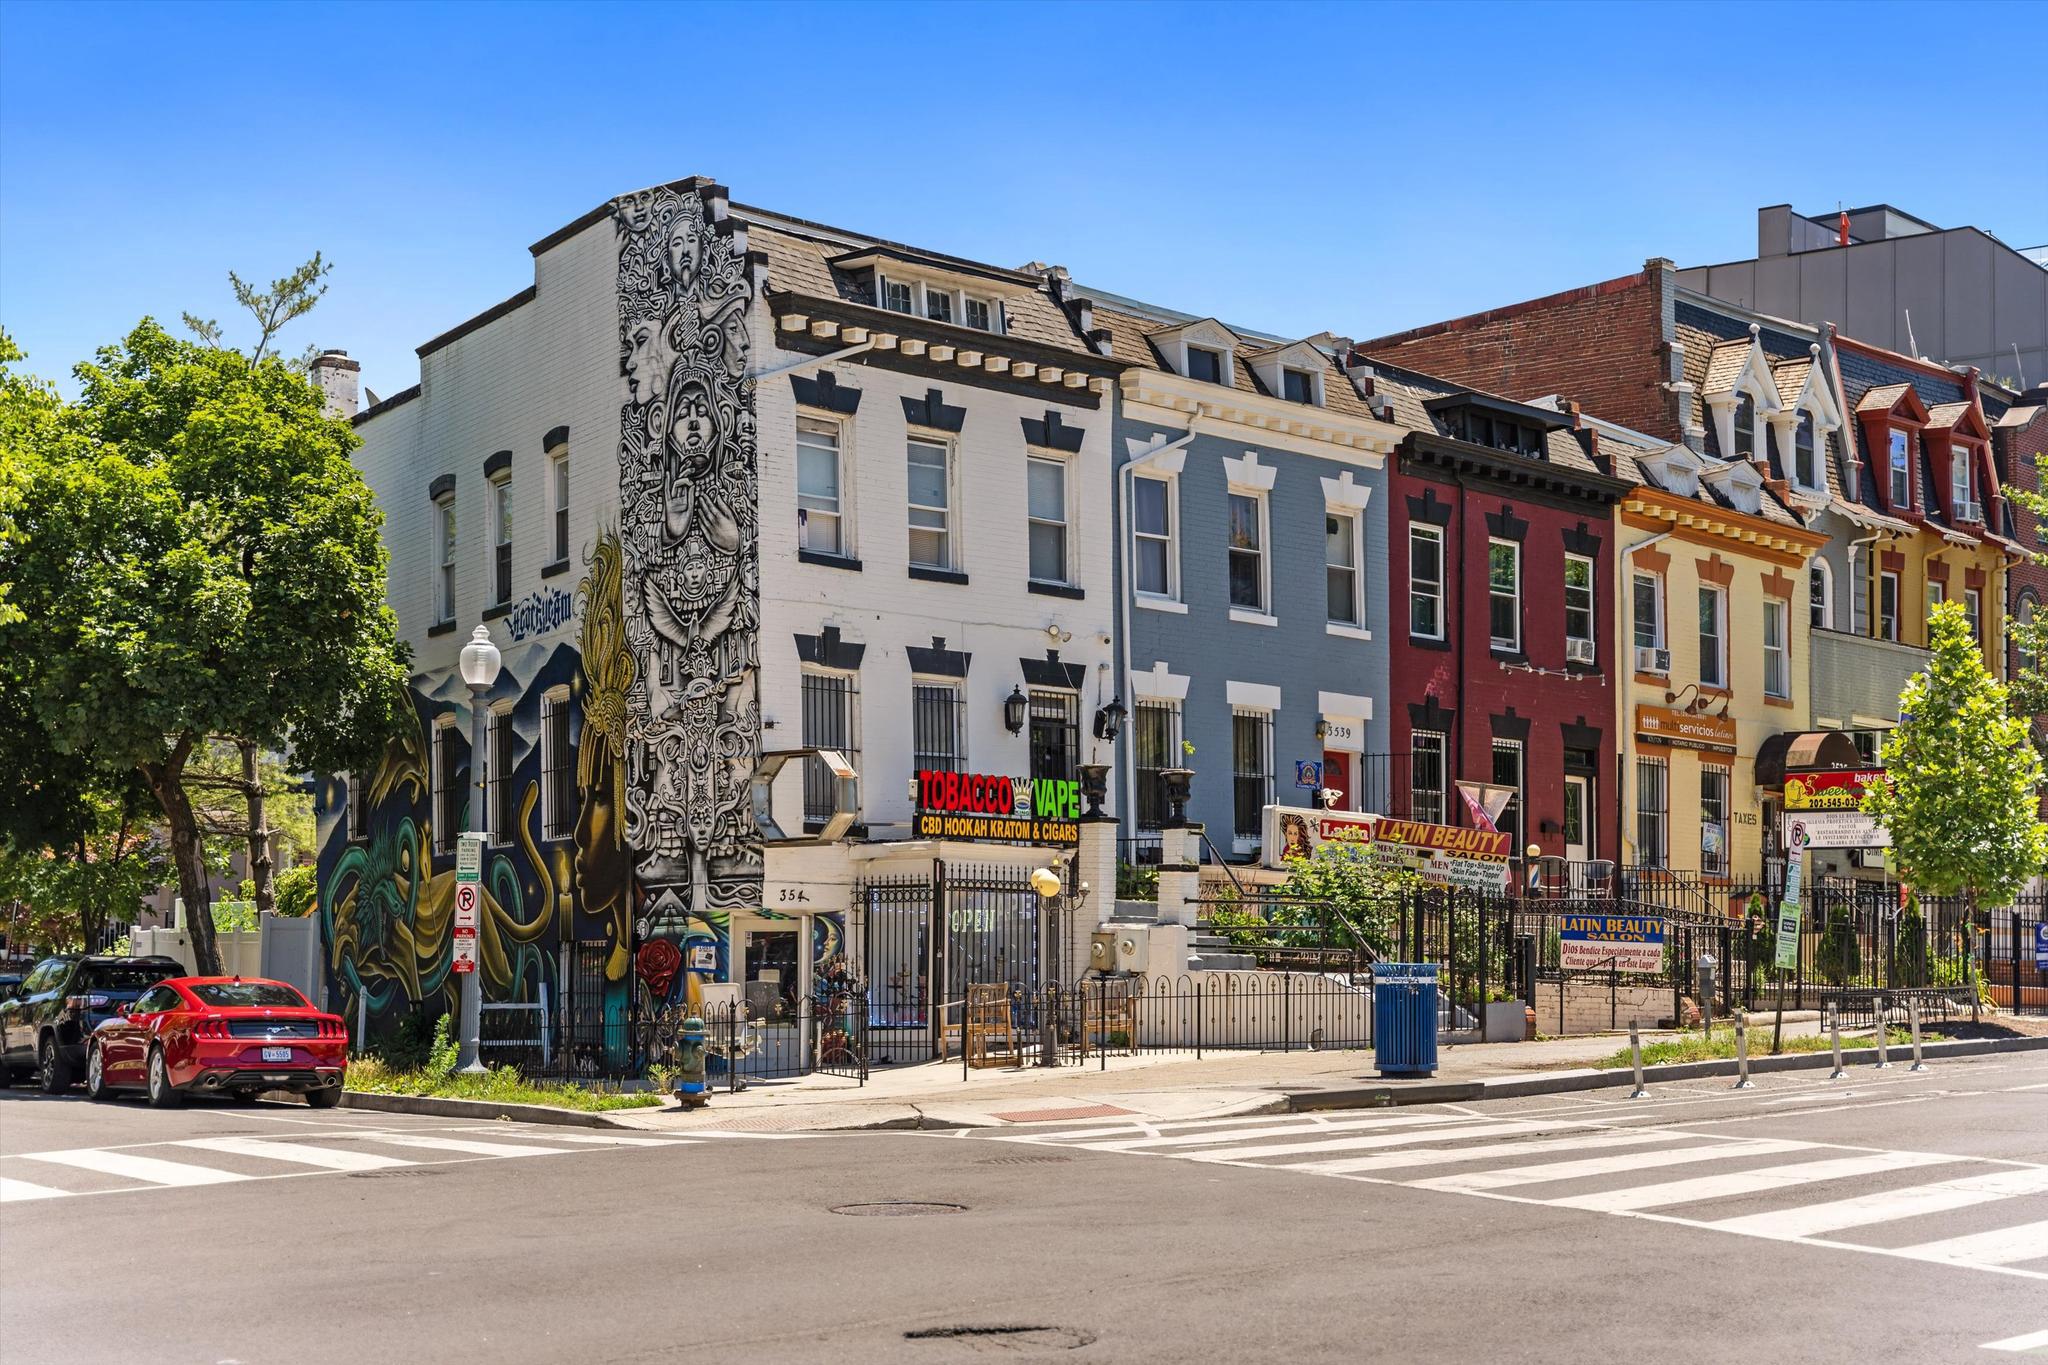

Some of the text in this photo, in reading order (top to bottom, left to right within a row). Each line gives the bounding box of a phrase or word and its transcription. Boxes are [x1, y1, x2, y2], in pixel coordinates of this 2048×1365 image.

[1326, 725, 1351, 739] 3539
[920, 770, 1012, 814] TOBACCO
[1033, 778, 1080, 818] VAPE
[1809, 798, 1864, 808] 202-545-035
[1734, 812, 1756, 825] TAXES
[921, 816, 1077, 841] CBD HOOKAH KRATOM & CIGARS
[1378, 820, 1505, 852] LATIN BEAUTY
[1445, 850, 1506, 863] SALON
[1430, 860, 1449, 870] MEN
[1448, 874, 1476, 885] Highlights
[1479, 879, 1501, 889] Relaxer
[952, 910, 995, 932] OPEN
[1562, 918, 1662, 934] LATIN BEAUTY
[1587, 933, 1645, 941] SALON
[1563, 943, 1578, 954] Dios
[1579, 946, 1600, 954] Bendice
[1602, 946, 1642, 957] Especialmente
[1648, 948, 1660, 957] cada
[1586, 958, 1596, 967] que
